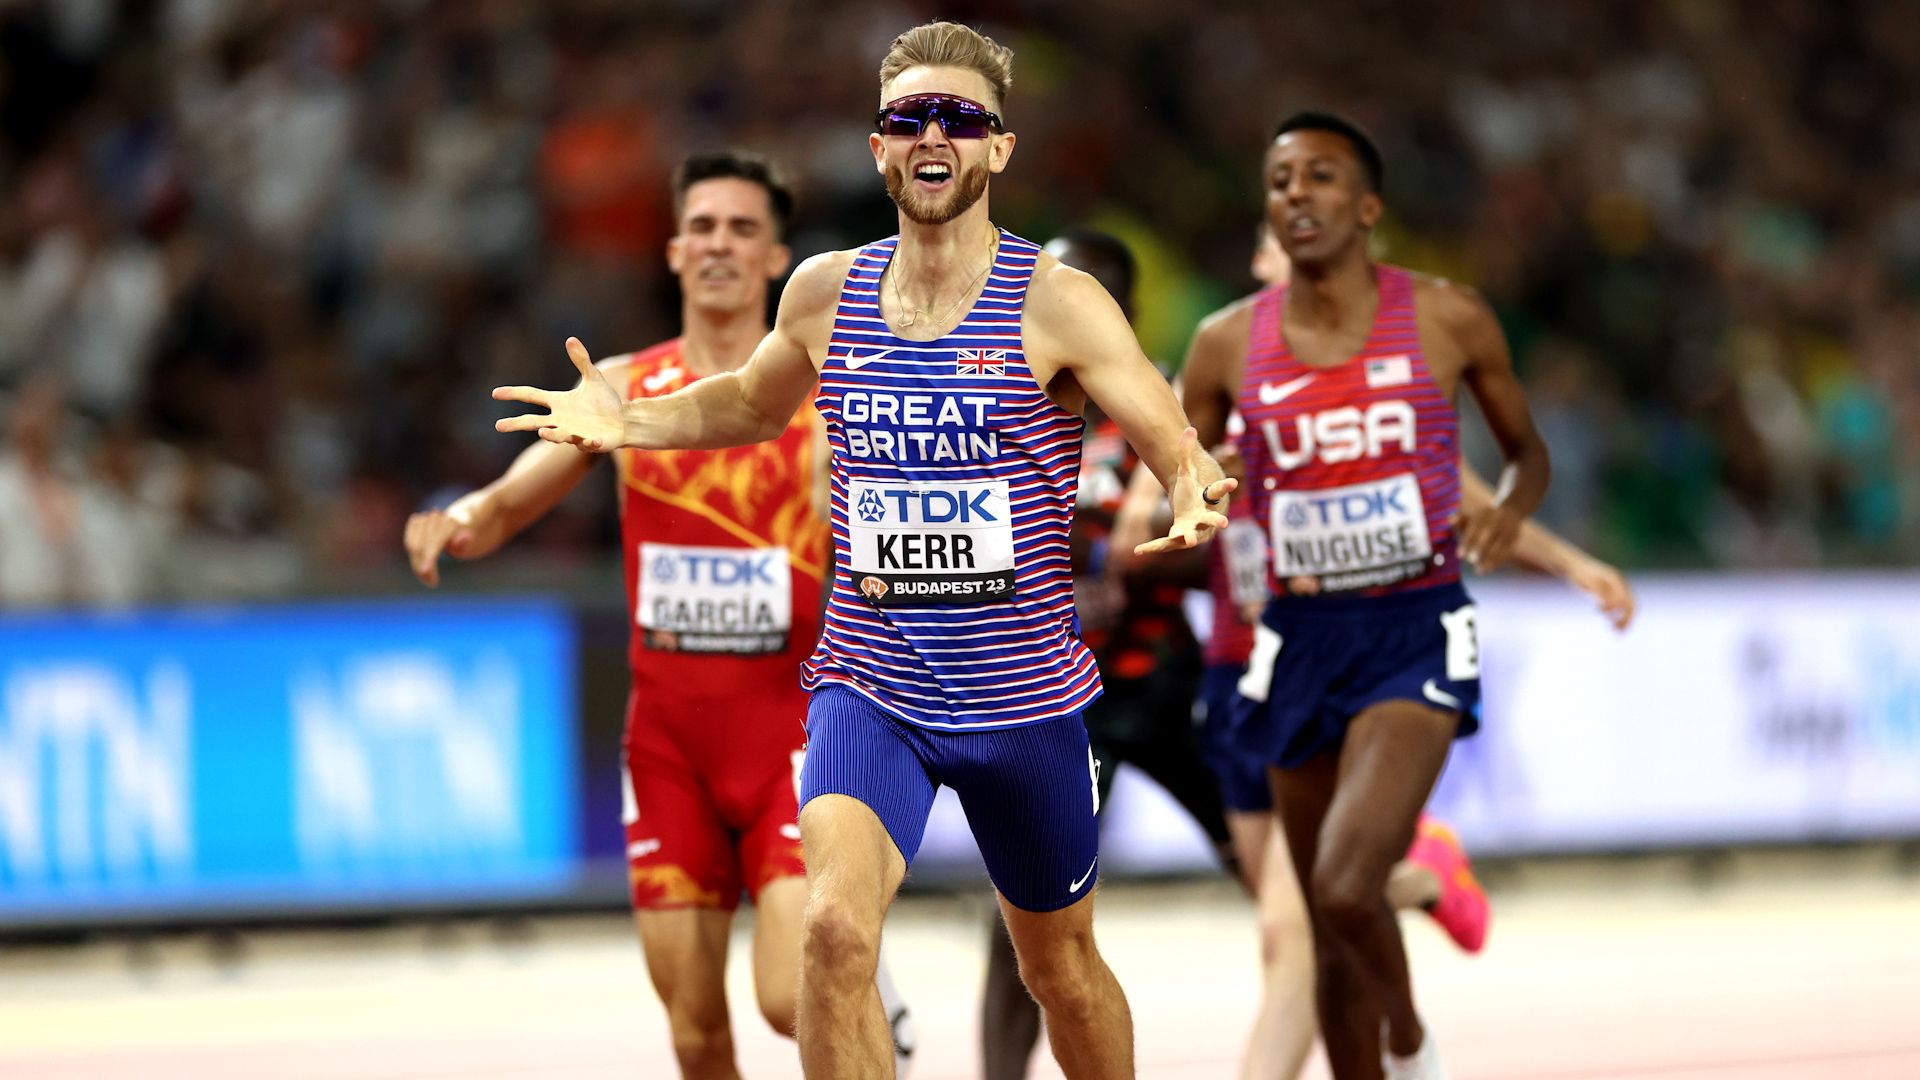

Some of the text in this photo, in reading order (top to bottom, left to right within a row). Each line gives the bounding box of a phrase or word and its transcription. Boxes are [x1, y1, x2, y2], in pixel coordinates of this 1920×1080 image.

[842, 391, 997, 427] GREAT
[845, 428, 998, 461] BRITAIN
[1262, 400, 1416, 470] USA
[884, 489, 998, 523] TDK
[1308, 487, 1406, 525] TDK
[877, 534, 976, 569] KERR
[1283, 522, 1416, 567] NUGUSE
[680, 554, 775, 585] TDK
[893, 578, 1006, 595] BUDAPEST 23
[652, 592, 774, 626] GARCÍA
